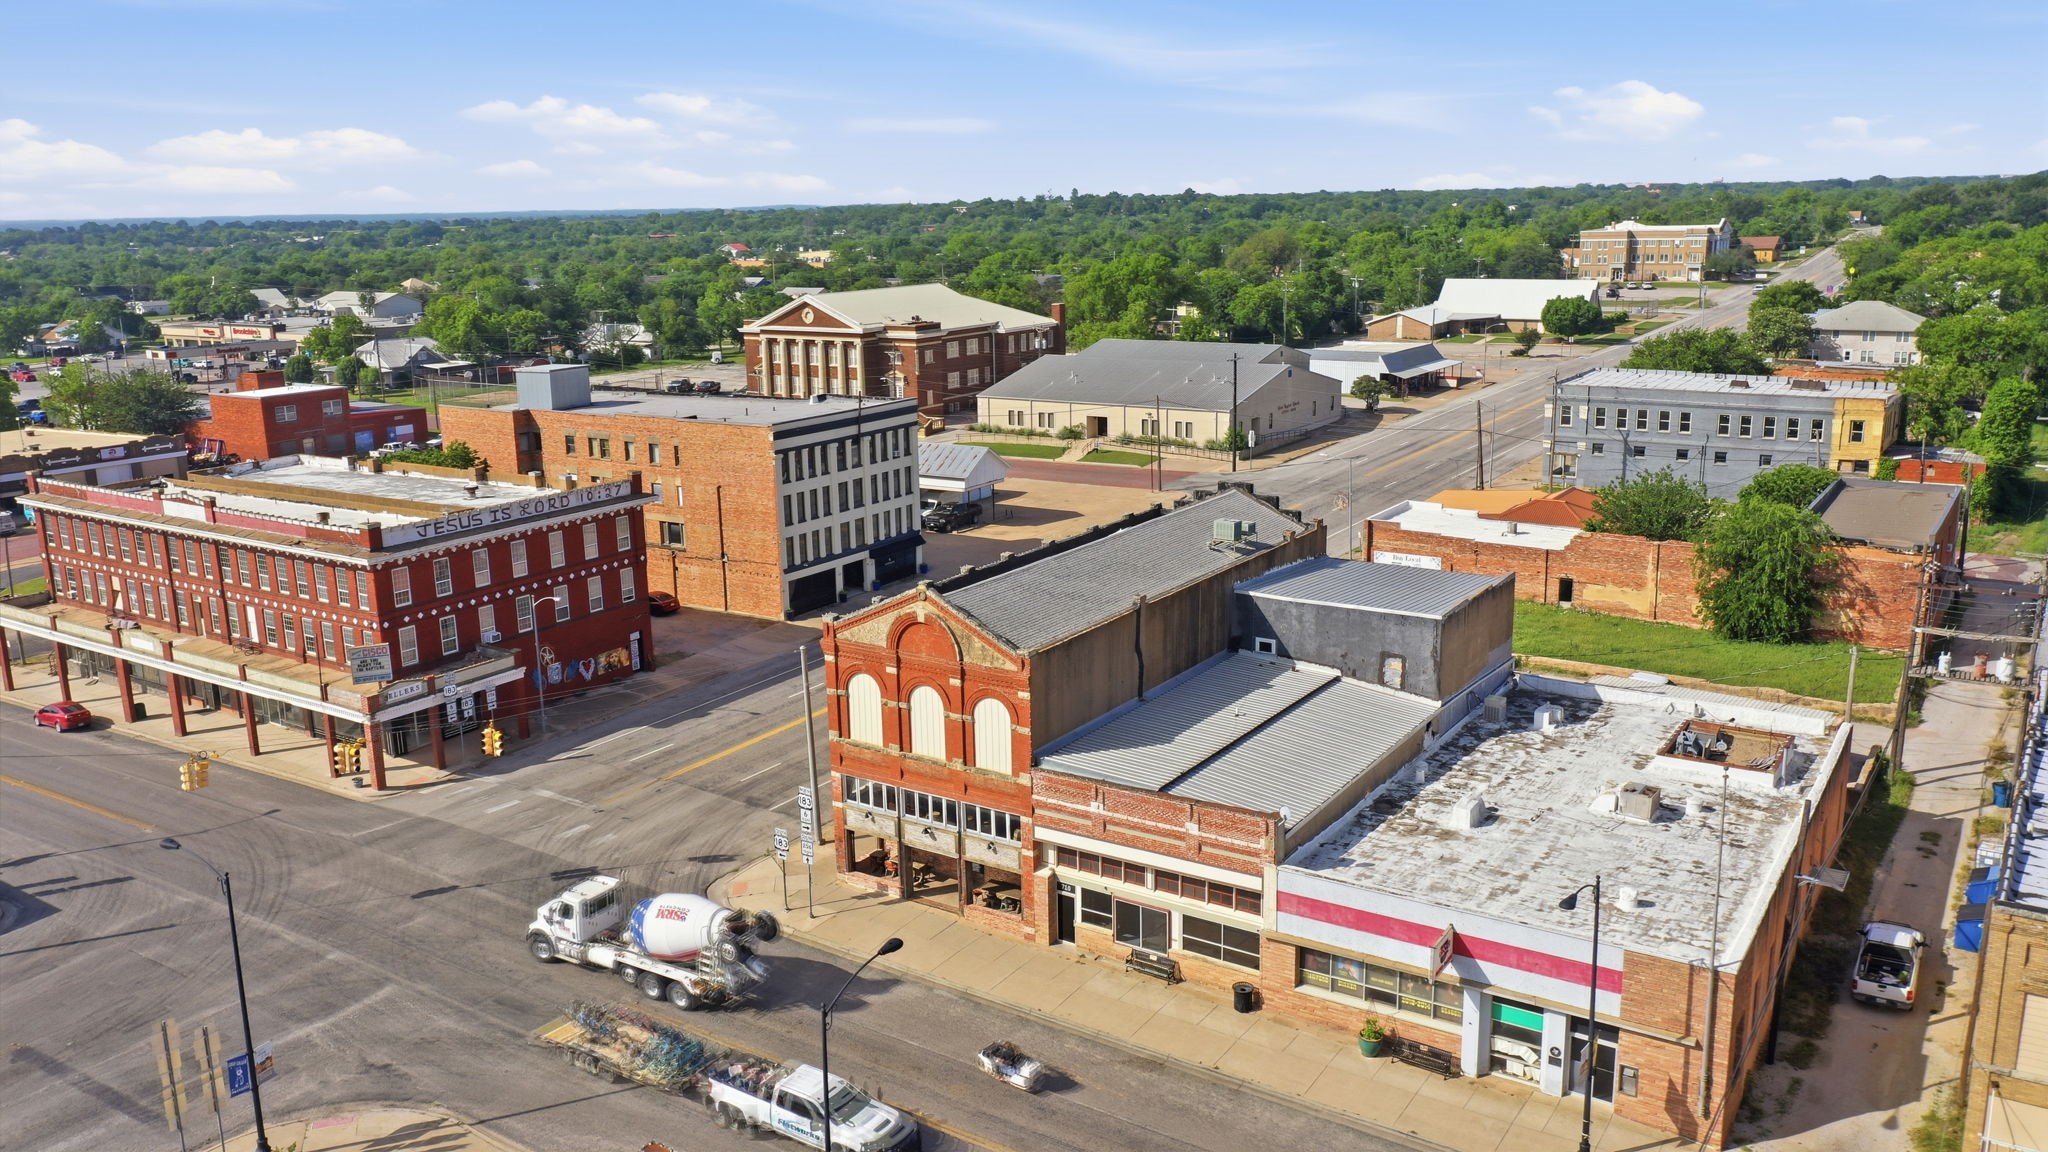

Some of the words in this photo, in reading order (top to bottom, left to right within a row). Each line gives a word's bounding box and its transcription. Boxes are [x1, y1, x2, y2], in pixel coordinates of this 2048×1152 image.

[416, 513, 483, 537] JESUS
[490, 508, 511, 523] IS
[520, 495, 569, 517] LORD
[580, 484, 622, 503] 10:27
[362, 646, 388, 657] CISCO
[445, 686, 455, 695] 183
[463, 699, 472, 708] 183
[799, 796, 811, 807] 183
[775, 837, 787, 848] 183
[656, 908, 682, 921] SRM
